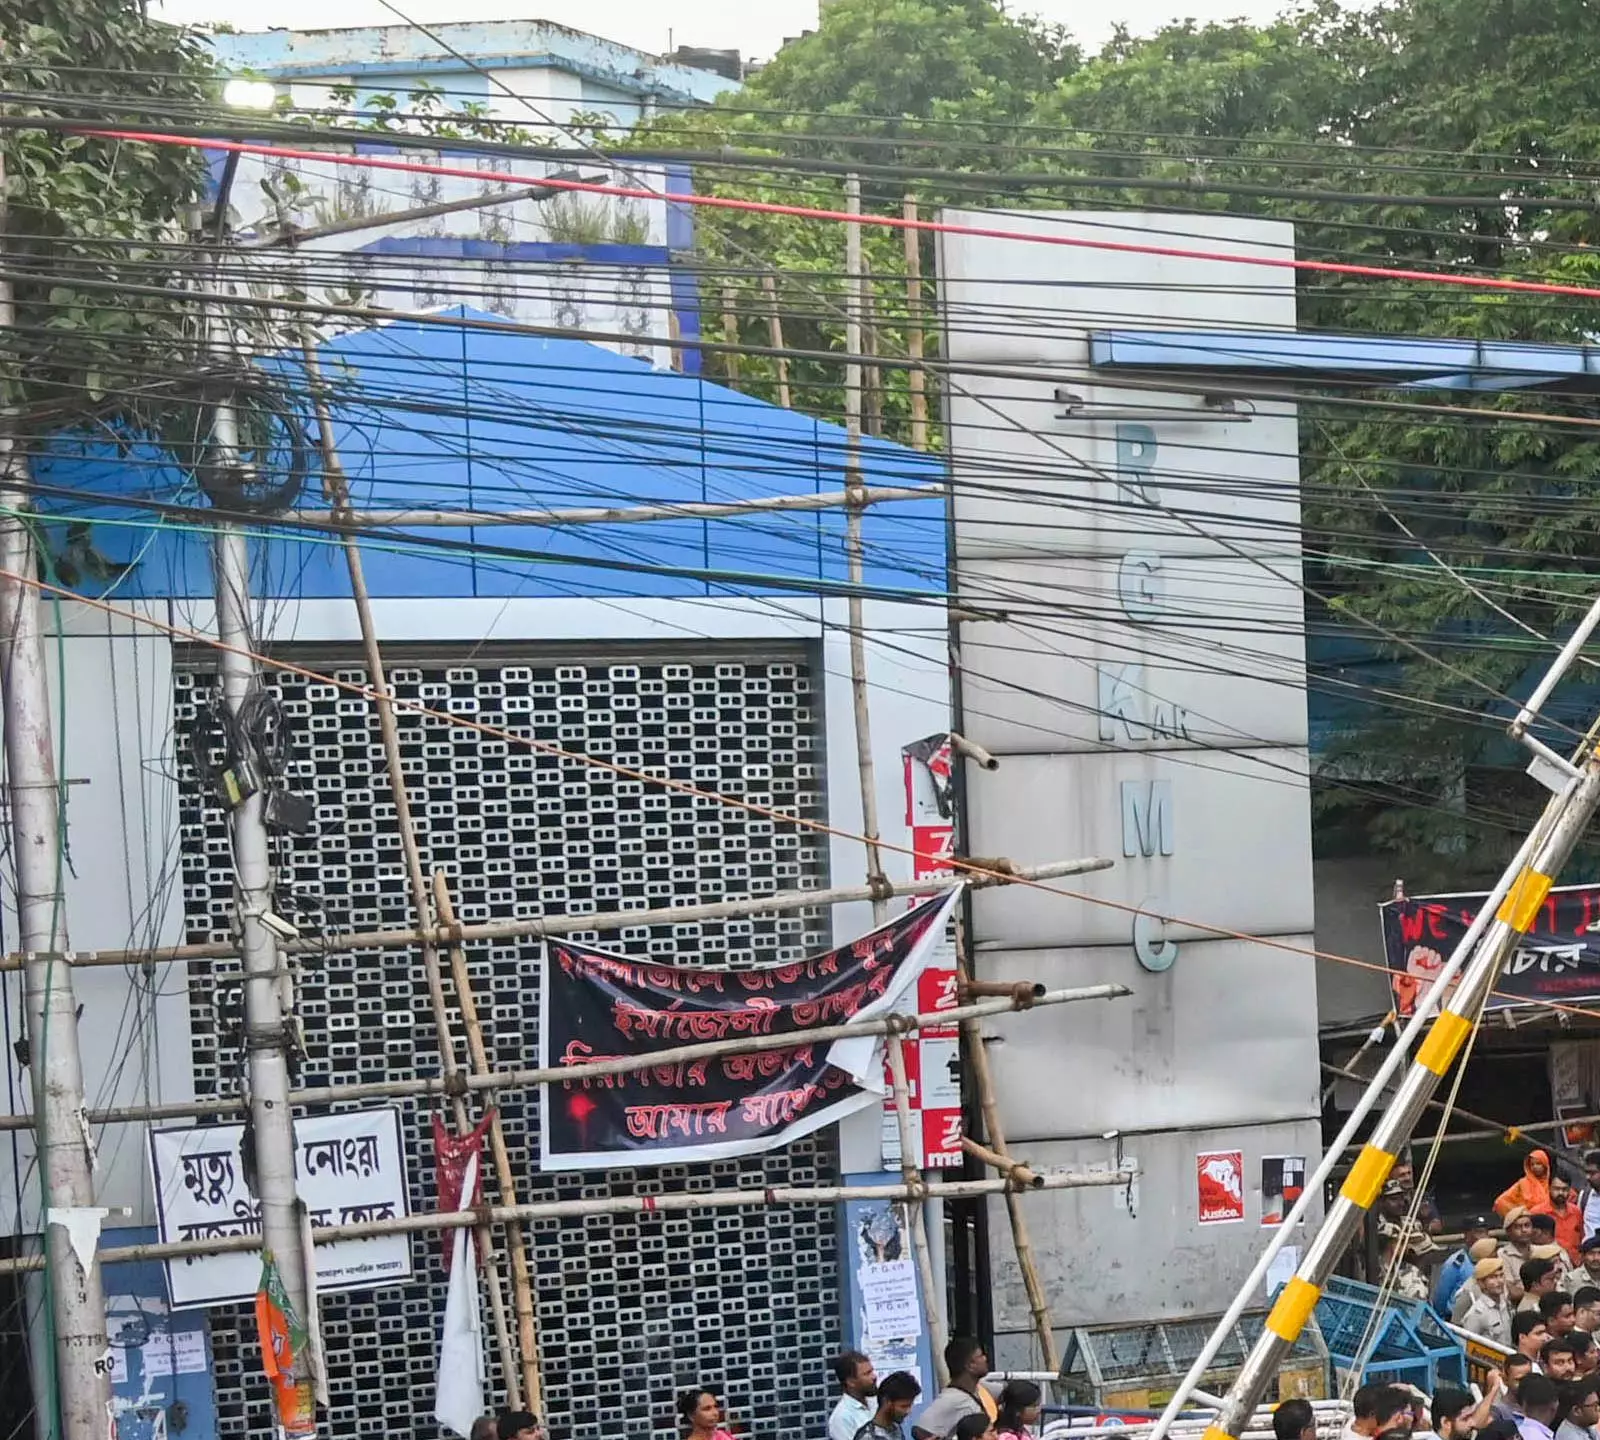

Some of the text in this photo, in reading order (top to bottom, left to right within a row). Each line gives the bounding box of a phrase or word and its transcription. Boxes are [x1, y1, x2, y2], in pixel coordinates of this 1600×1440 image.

[1116, 424, 1160, 503] R
[1121, 780, 1174, 857] M
[1133, 902, 1179, 973] C
[1401, 902, 1449, 942] WE
[624, 1098, 733, 1139] আমার
[303, 1135, 381, 1179] নোংরা
[1200, 1207, 1240, 1220] Justice.
